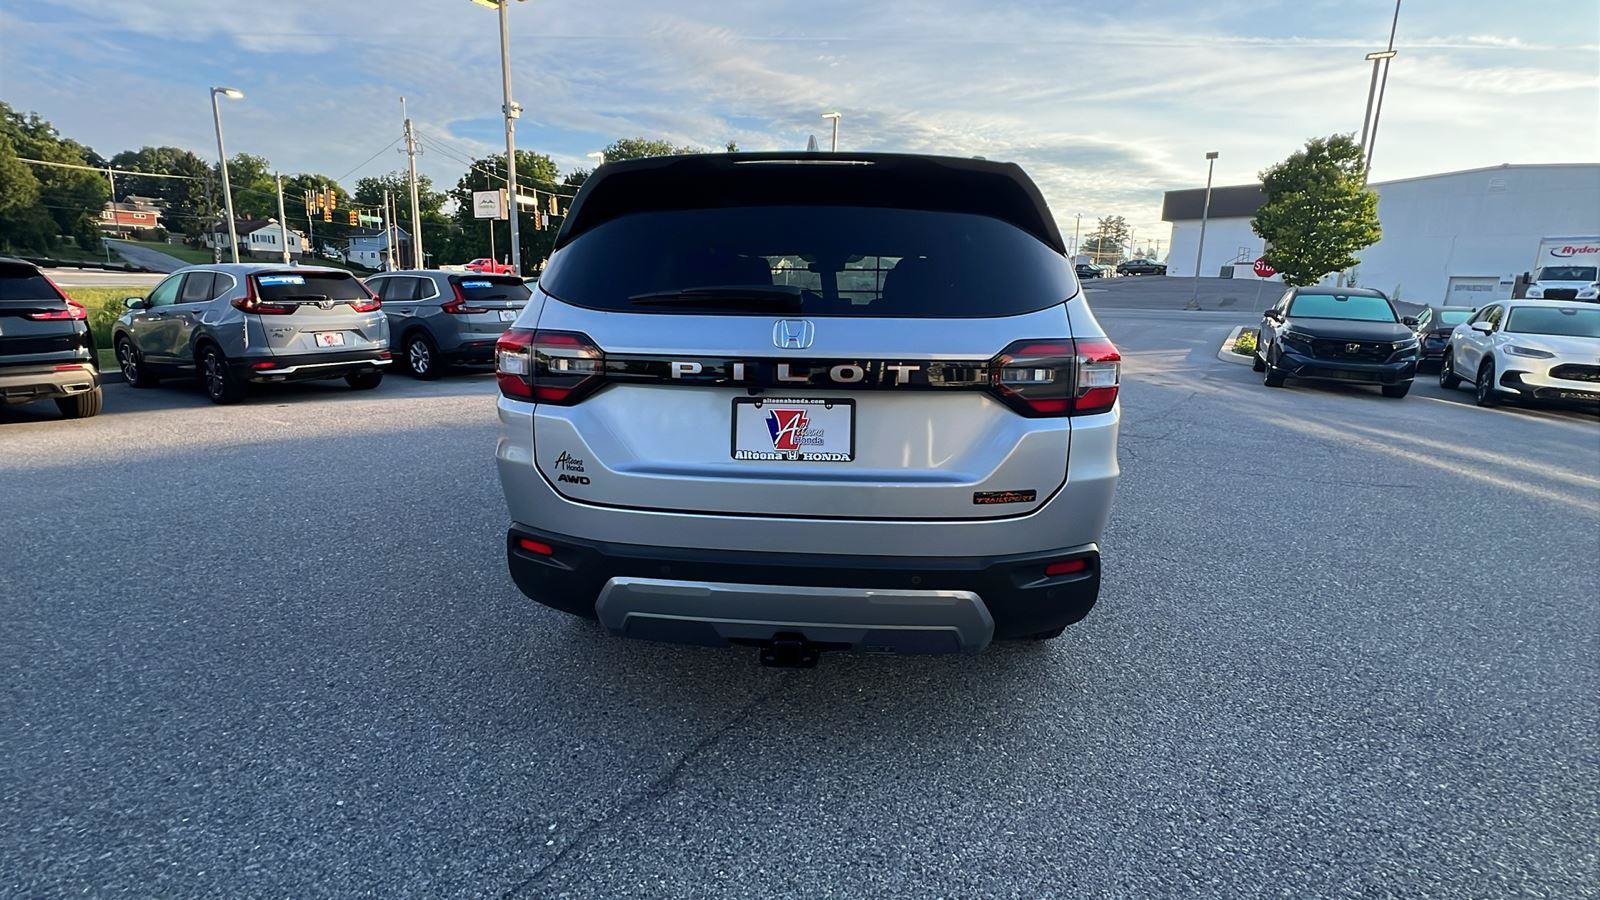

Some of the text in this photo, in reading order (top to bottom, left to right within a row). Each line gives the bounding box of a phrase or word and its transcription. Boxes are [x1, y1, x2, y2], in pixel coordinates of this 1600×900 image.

[1562, 246, 1600, 255] Ryder
[1255, 261, 1275, 271] STO
[671, 361, 920, 383] PILOT
[794, 437, 825, 446] Honda
[735, 450, 783, 460] Altoona
[803, 453, 851, 461] HONDA
[558, 474, 591, 485] AWD
